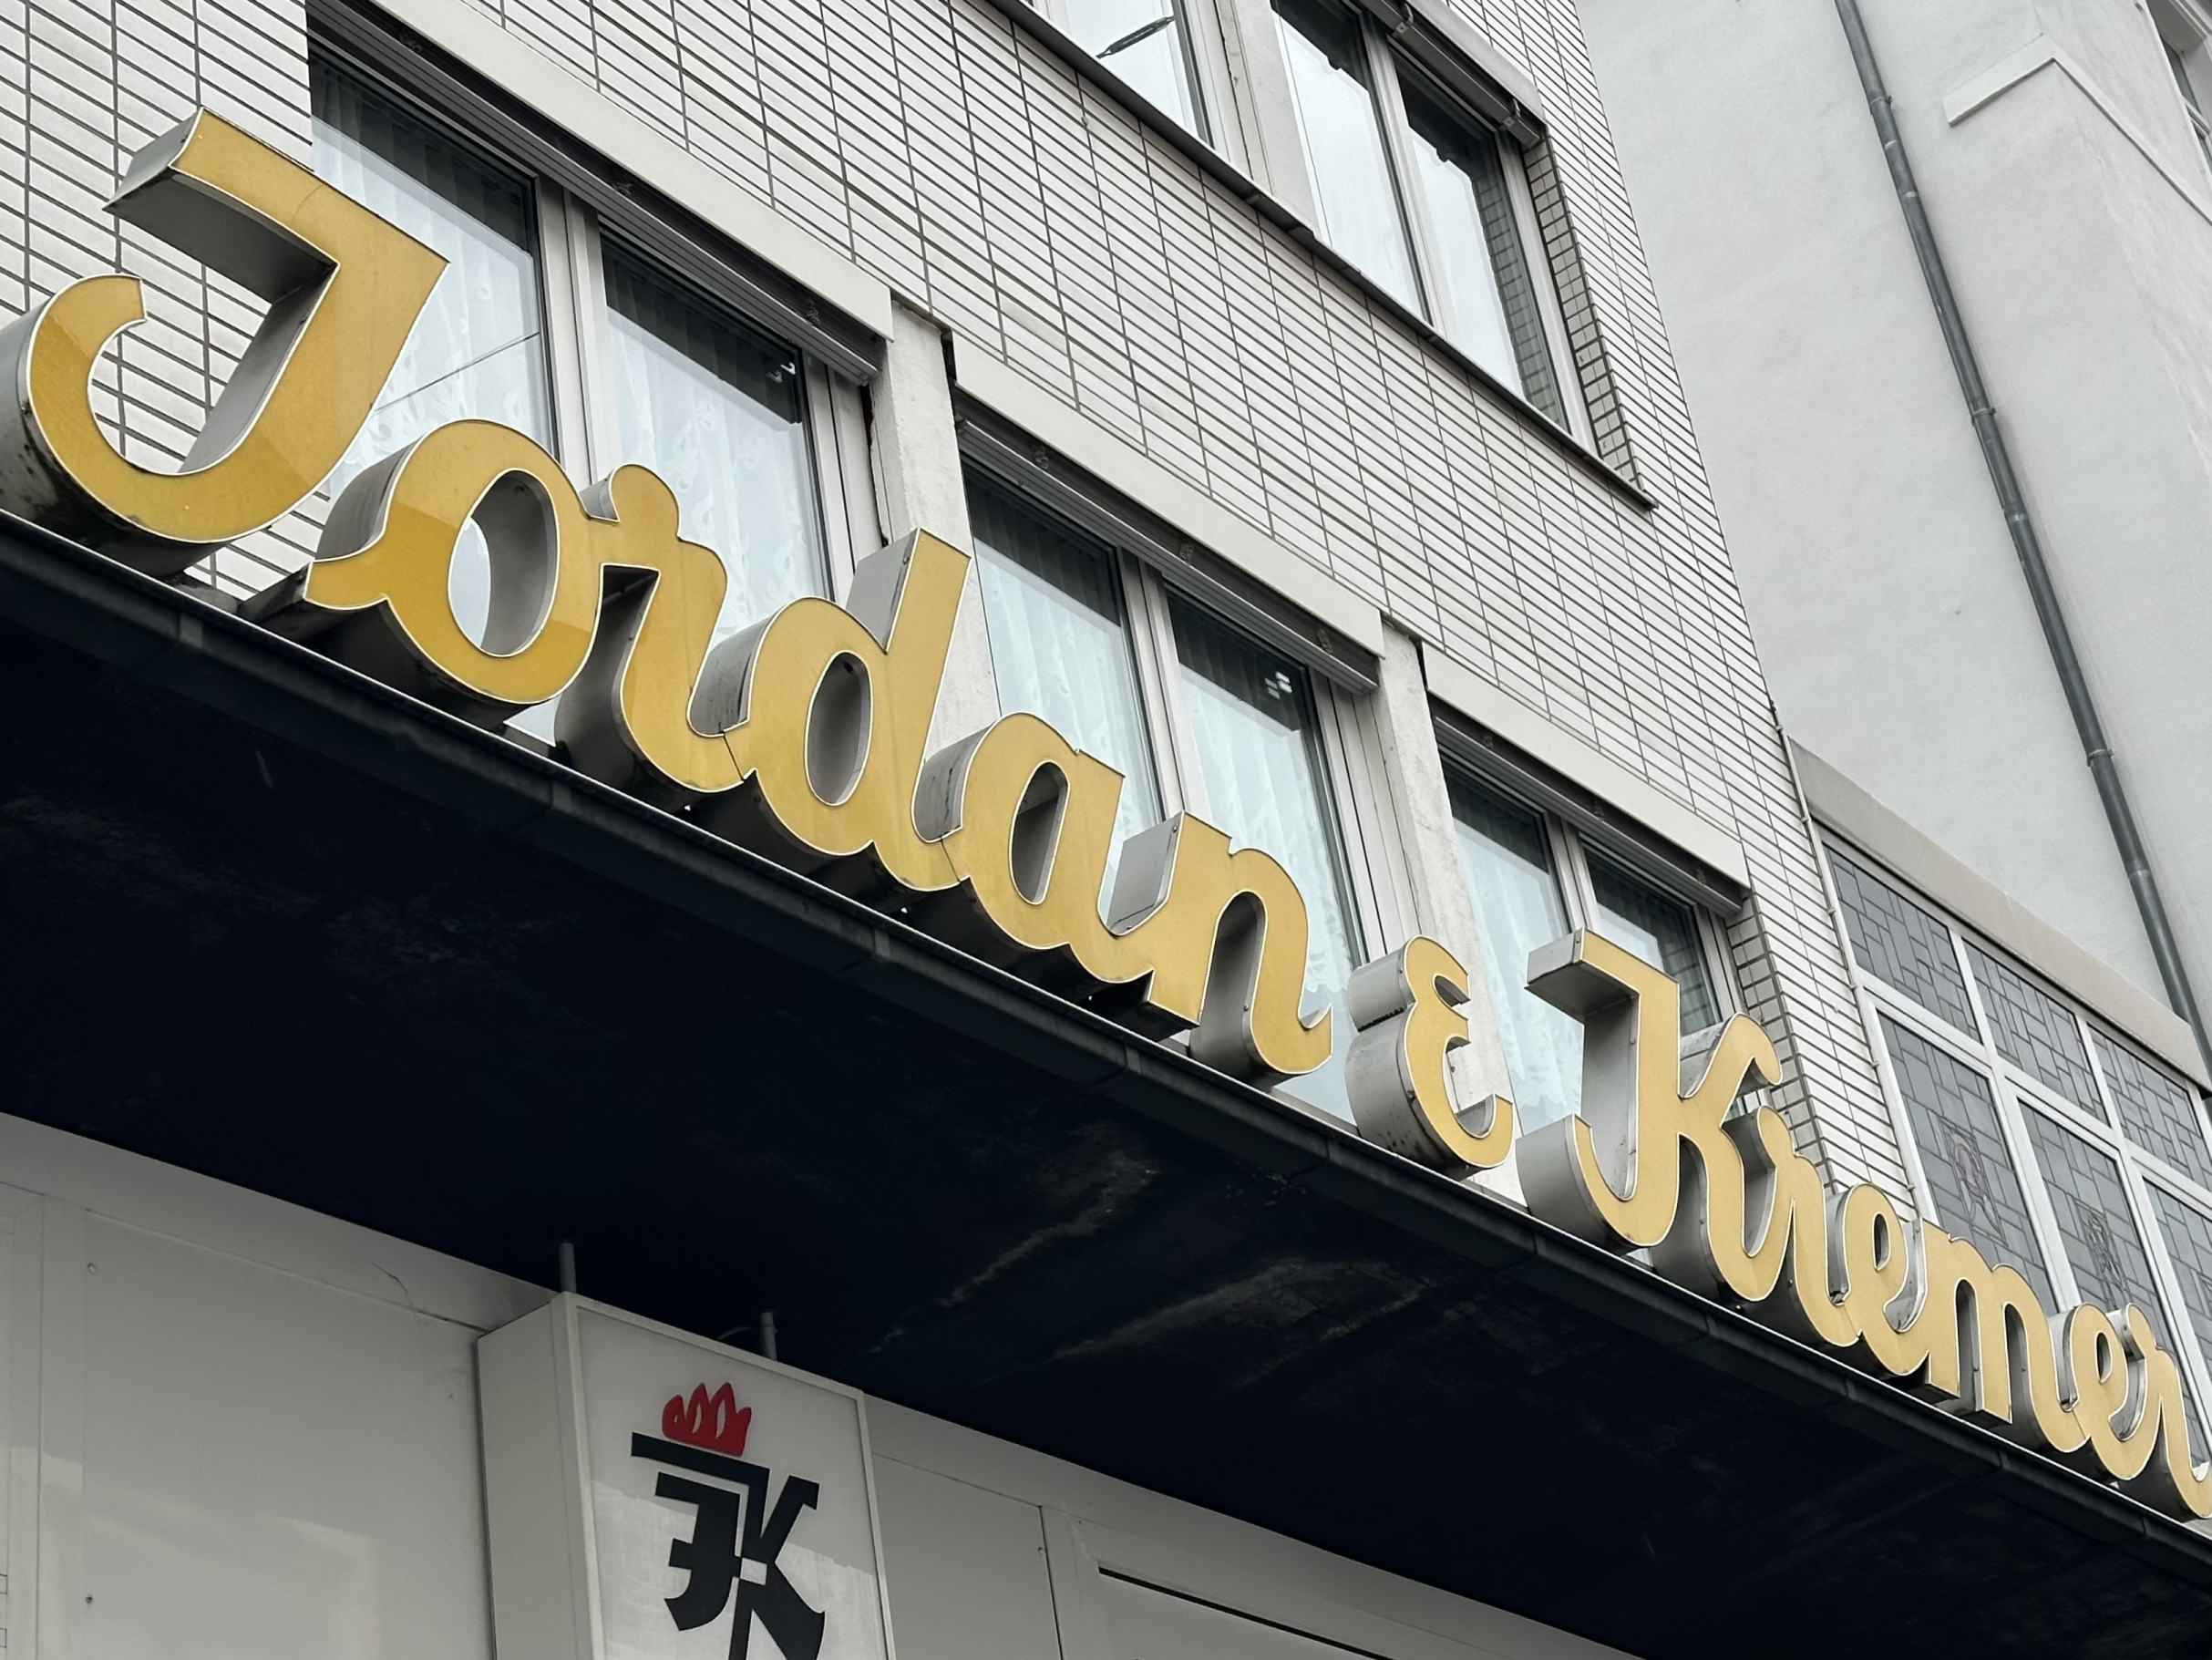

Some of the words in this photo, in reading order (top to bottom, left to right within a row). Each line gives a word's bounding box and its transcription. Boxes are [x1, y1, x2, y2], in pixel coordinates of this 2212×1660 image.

[26, 106, 1333, 1075] Jordan
[1402, 934, 1514, 1169] &
[1571, 926, 2212, 1519] Kremer
